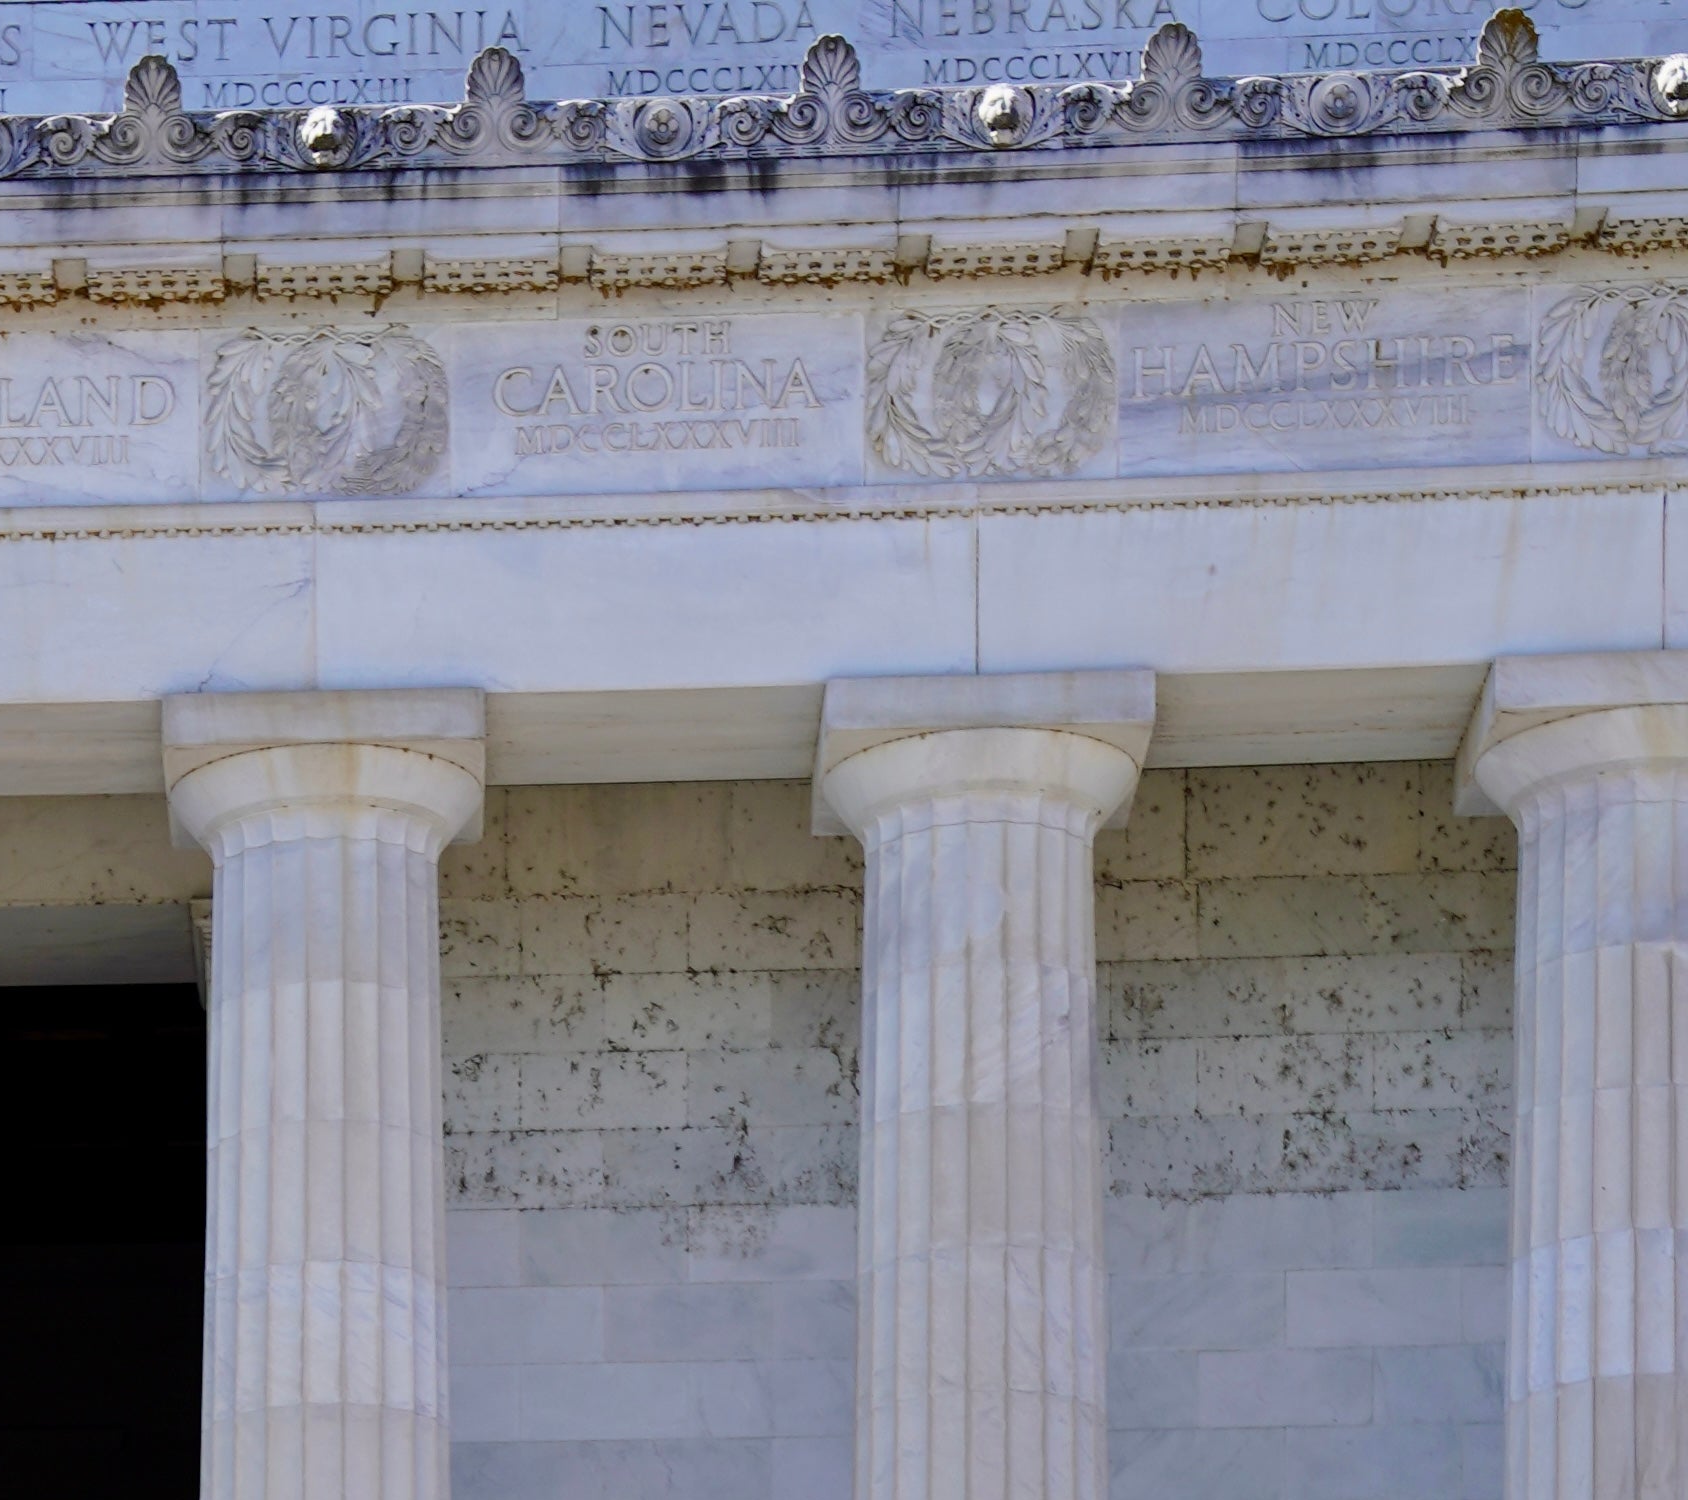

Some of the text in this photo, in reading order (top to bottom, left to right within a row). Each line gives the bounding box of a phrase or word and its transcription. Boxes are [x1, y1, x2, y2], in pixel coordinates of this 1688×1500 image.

[86, 10, 530, 66] WEST VIRGINIA
[598, 0, 816, 49] NEVADA
[203, 77, 411, 109] MDCCCLXIII
[1271, 299, 1379, 337] NEW
[584, 320, 732, 359] SOUTH
[493, 357, 824, 416] CAROLINA
[1131, 333, 1518, 399] HAMPSHIRE
[1179, 394, 1472, 435] MDCCLXXXVIII
[514, 417, 800, 456] MDCCLXXXVIII
